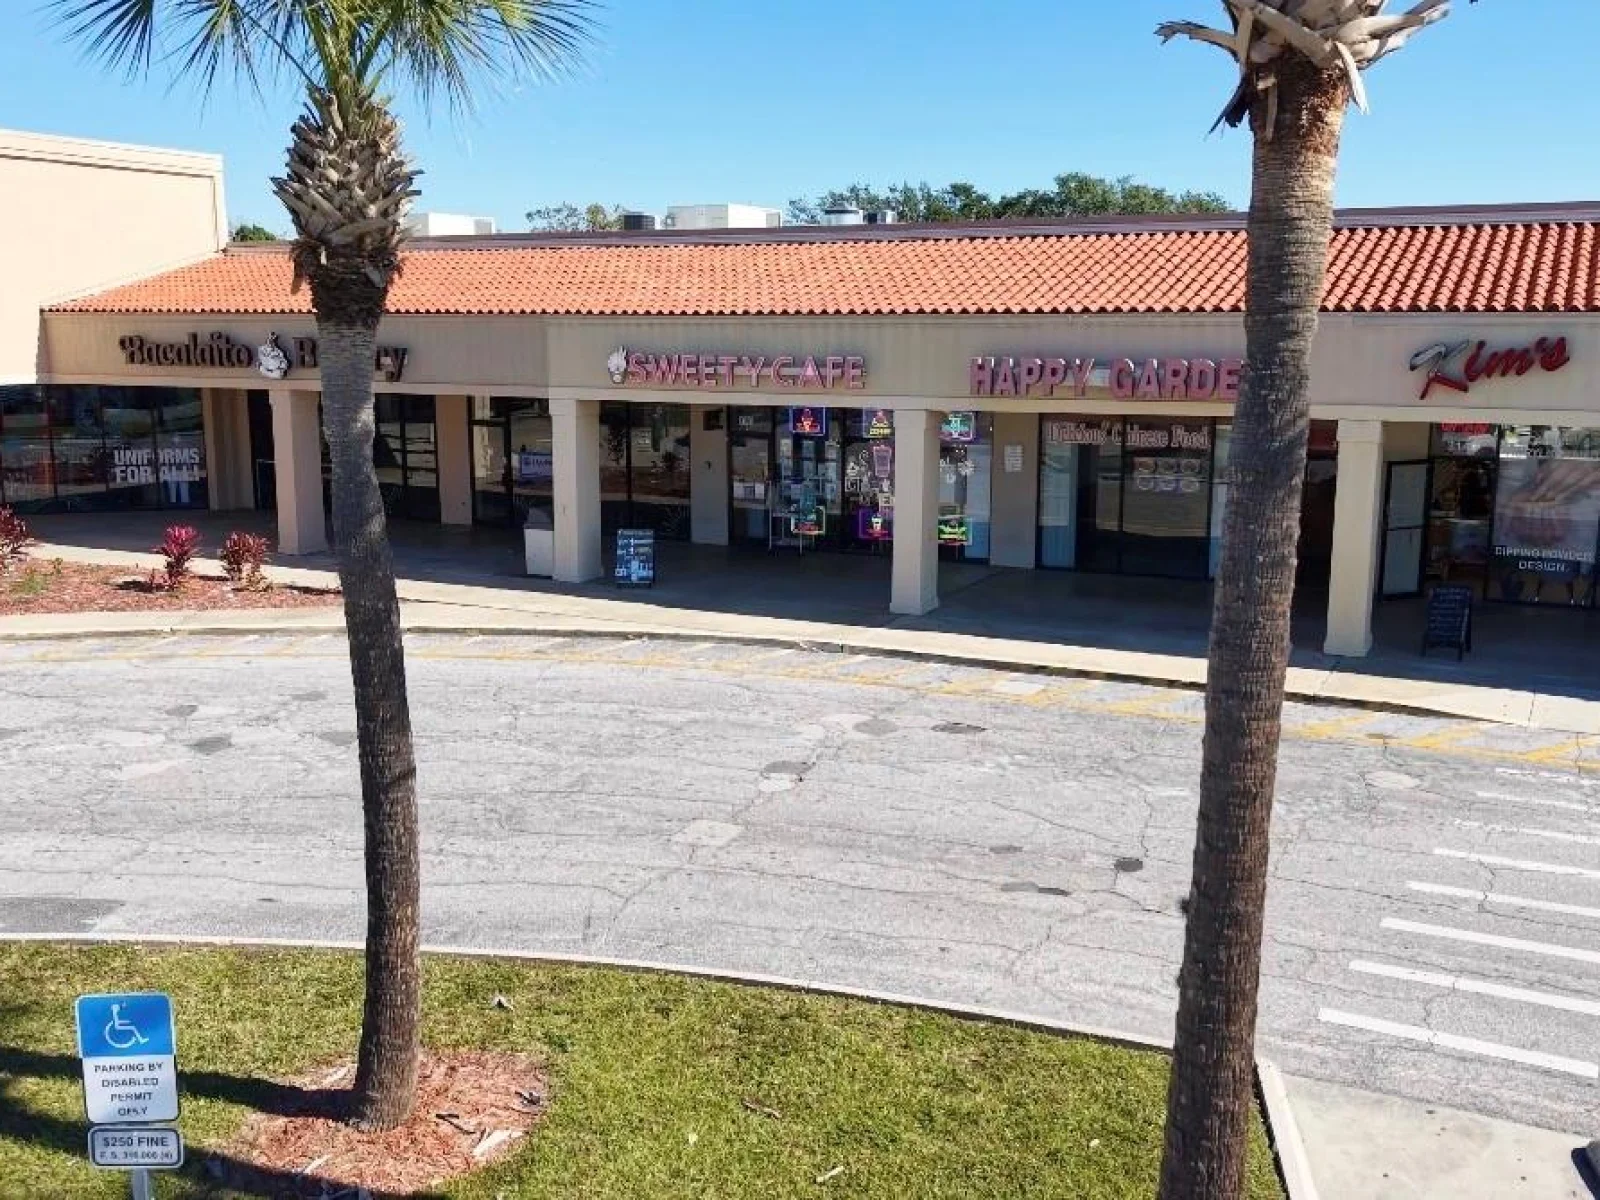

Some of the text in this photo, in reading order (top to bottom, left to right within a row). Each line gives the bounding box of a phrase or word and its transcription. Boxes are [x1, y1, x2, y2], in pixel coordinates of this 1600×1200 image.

[118, 331, 408, 382] Bacalaito Bry
[628, 353, 867, 389] SWEETY CAFE
[1409, 336, 1570, 400] Kim's
[969, 356, 1243, 402] HAPPY GARDE
[115, 466, 152, 484] FOR
[1518, 561, 1565, 572] DESIGN
[94, 1062, 163, 1073] PARKING BY
[101, 1077, 159, 1088] DISABLED
[110, 1092, 153, 1102] PERMIT
[118, 1107, 148, 1116] ONLY
[103, 1136, 169, 1147] $250 FINE
